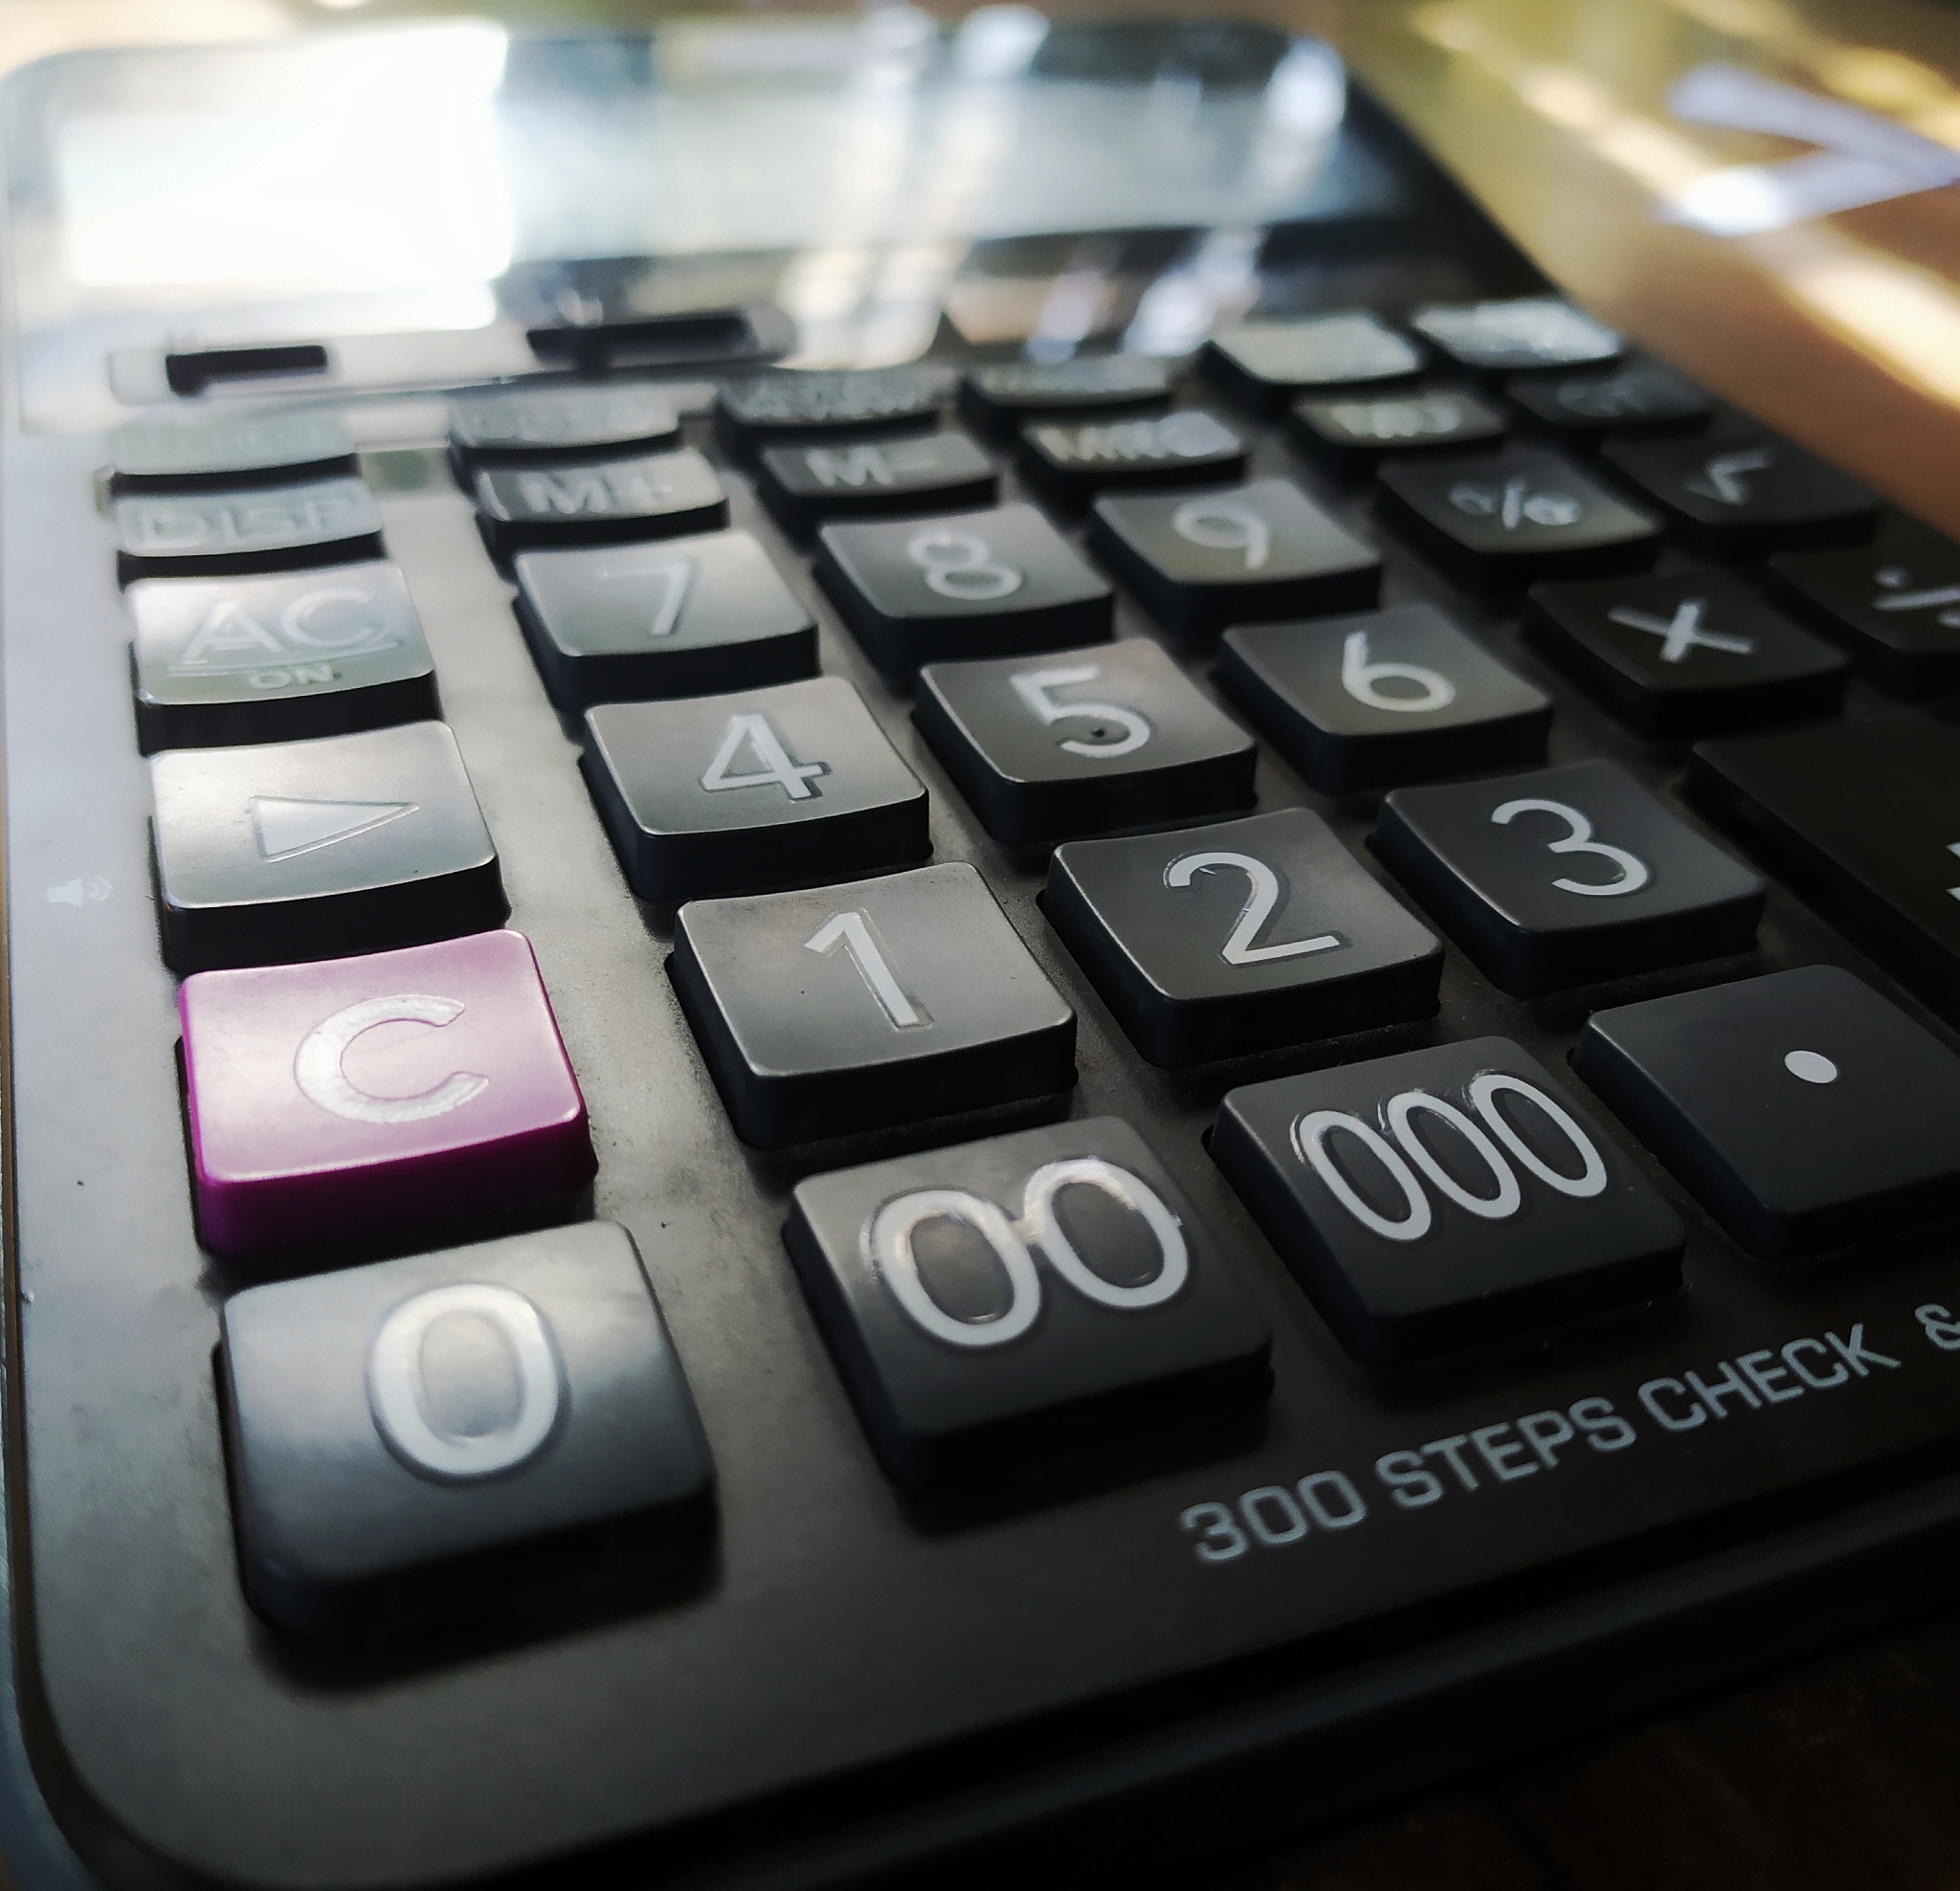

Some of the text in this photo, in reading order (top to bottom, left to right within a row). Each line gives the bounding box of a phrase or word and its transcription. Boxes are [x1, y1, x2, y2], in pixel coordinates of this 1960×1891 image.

[906, 527, 1024, 601] 8
[1172, 497, 1269, 571] 9
[181, 587, 392, 666] AC
[602, 553, 699, 636] 7
[250, 662, 341, 690] ON
[1010, 664, 1151, 758] 5
[1341, 630, 1457, 713] 6
[699, 713, 831, 802] 4
[1490, 797, 1651, 897] 3
[1163, 850, 1350, 966] 2
[802, 909, 932, 1034] 1
[294, 993, 489, 1123] C
[1290, 1069, 1609, 1243] 000
[1178, 1469, 1369, 1563] 300
[1374, 1395, 1638, 1509] STEPS
[1636, 1322, 1903, 1434] CHECK
